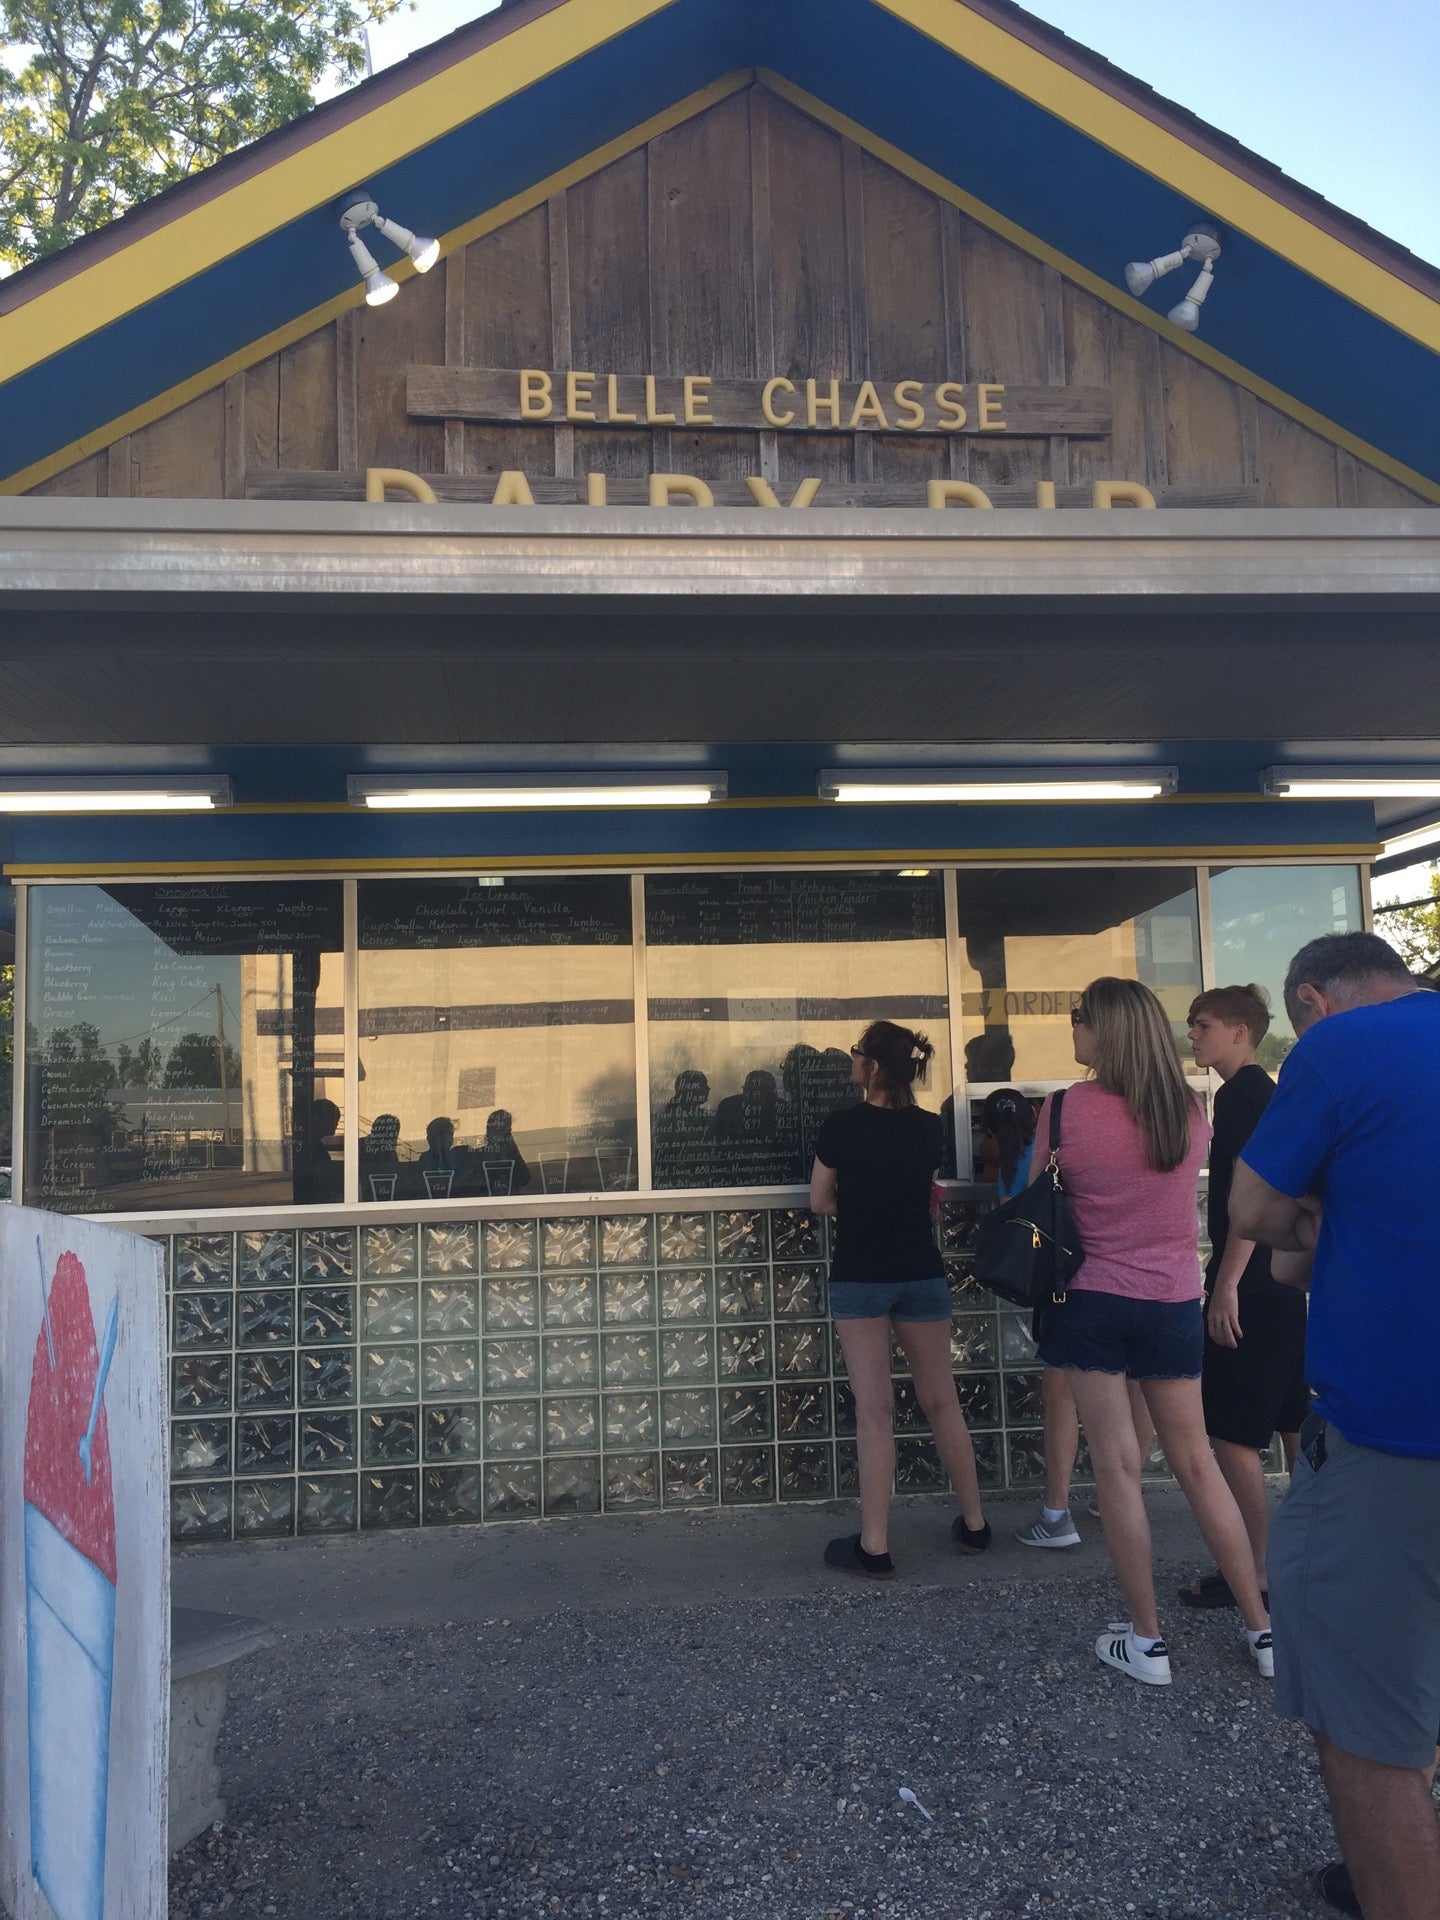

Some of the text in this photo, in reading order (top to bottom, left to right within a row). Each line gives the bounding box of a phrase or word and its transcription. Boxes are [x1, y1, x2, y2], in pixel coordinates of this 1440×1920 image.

[519, 369, 1007, 432] BELLE CHASSE
[277, 901, 314, 913] Jumbo
[523, 902, 571, 914] Vanilla
[568, 916, 601, 928] Jumbo
[44, 976, 89, 992] Blueberry
